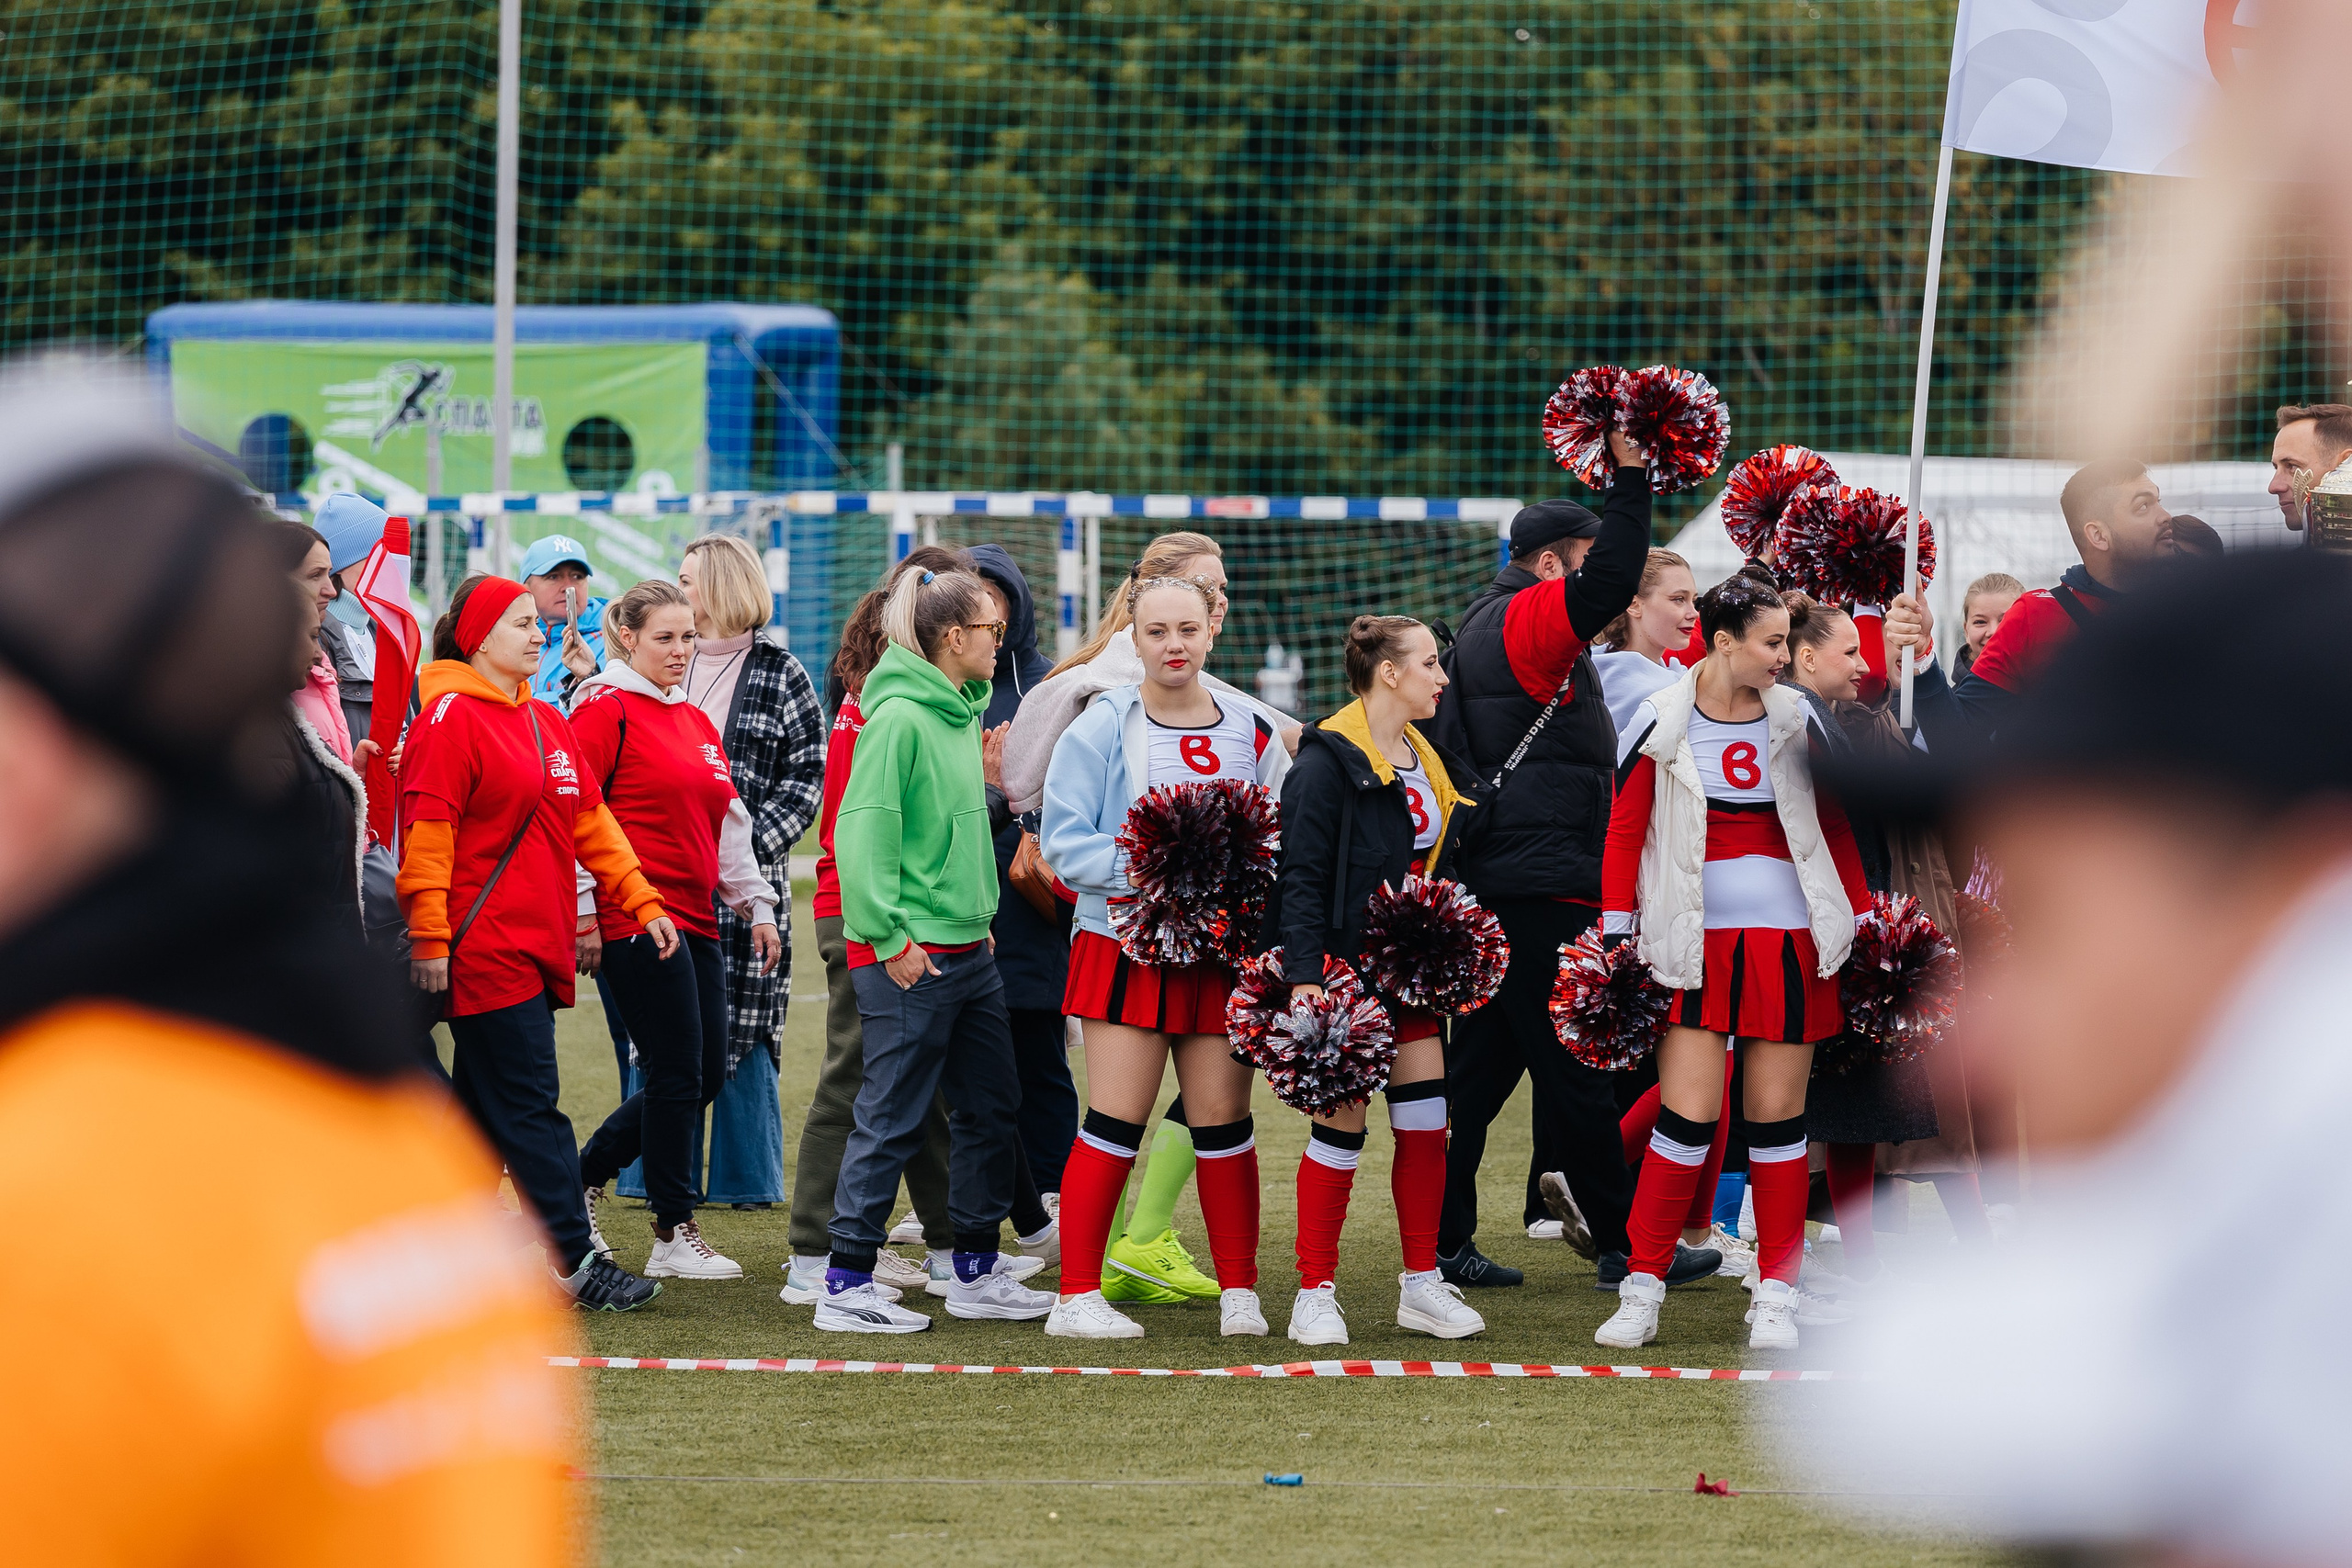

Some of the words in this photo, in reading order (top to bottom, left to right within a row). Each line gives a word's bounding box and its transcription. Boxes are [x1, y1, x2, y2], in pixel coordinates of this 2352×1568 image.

[435, 399, 544, 433] СПАТА
[1523, 697, 1559, 743] adidas
[1459, 1256, 1488, 1280] N
